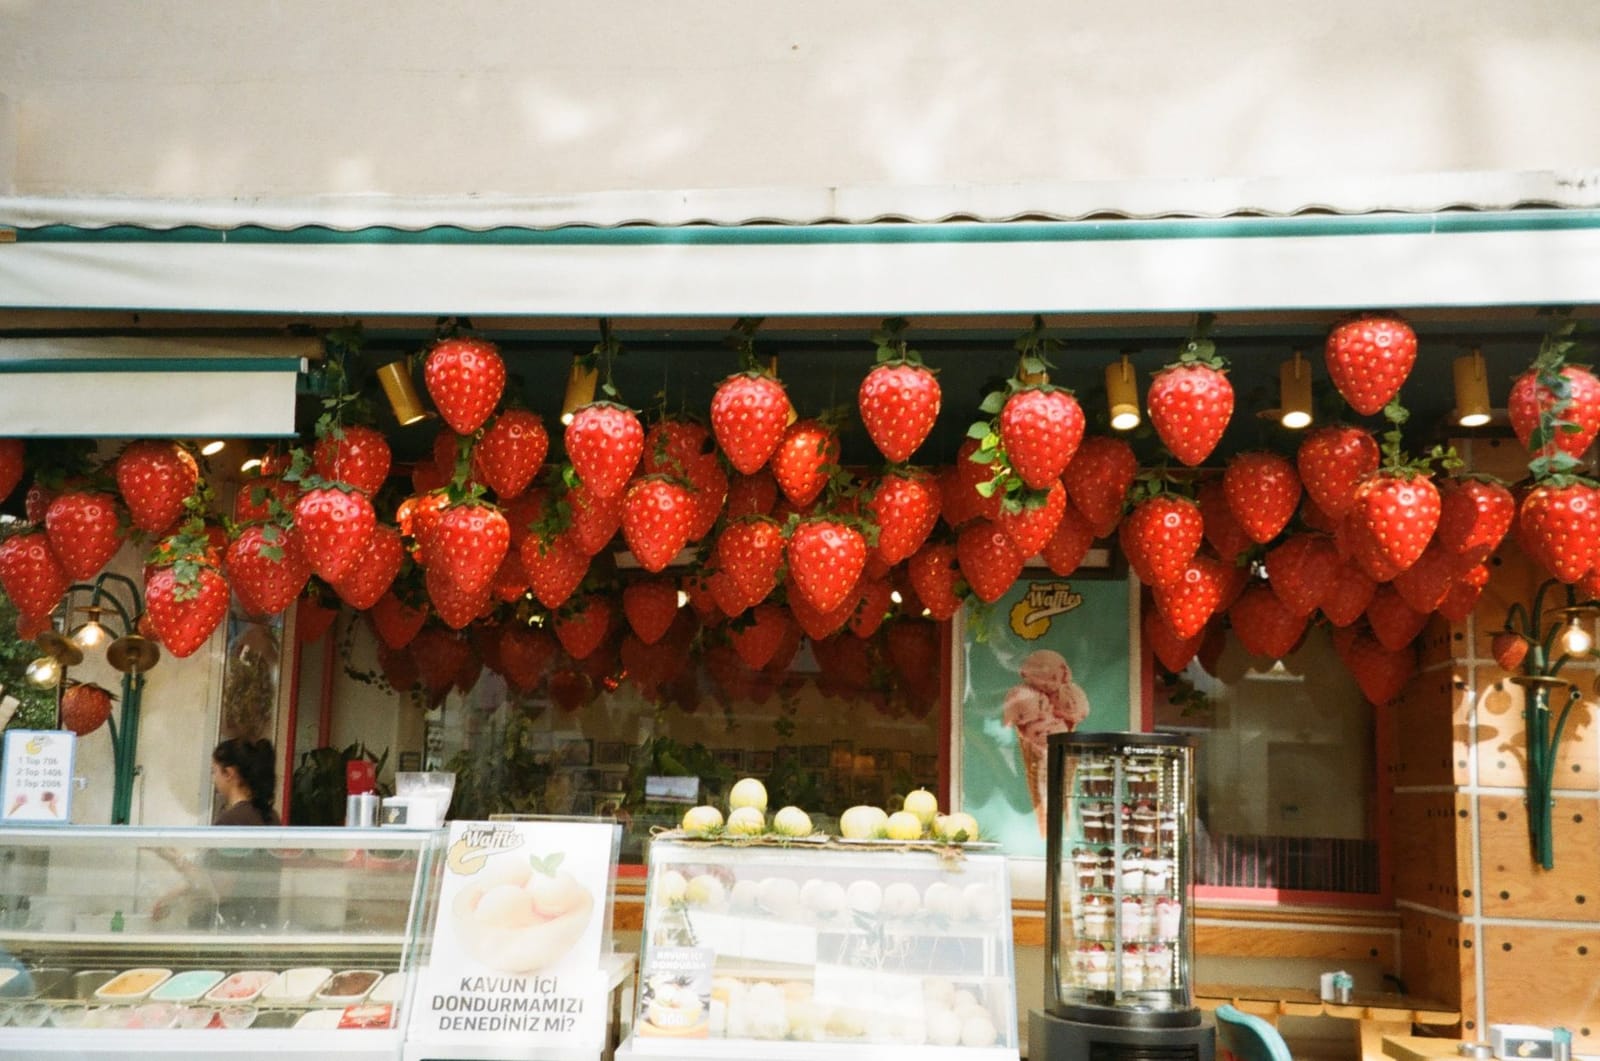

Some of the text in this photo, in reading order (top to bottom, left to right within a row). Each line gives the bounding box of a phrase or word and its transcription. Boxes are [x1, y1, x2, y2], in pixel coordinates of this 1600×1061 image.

[1026, 590, 1082, 609] Waffles
[460, 975, 558, 995] KAVUN İÇİ
[431, 994, 584, 1014] DONDURMAMIZI
[438, 1013, 576, 1033] DENEDİNİZ Mİ?
